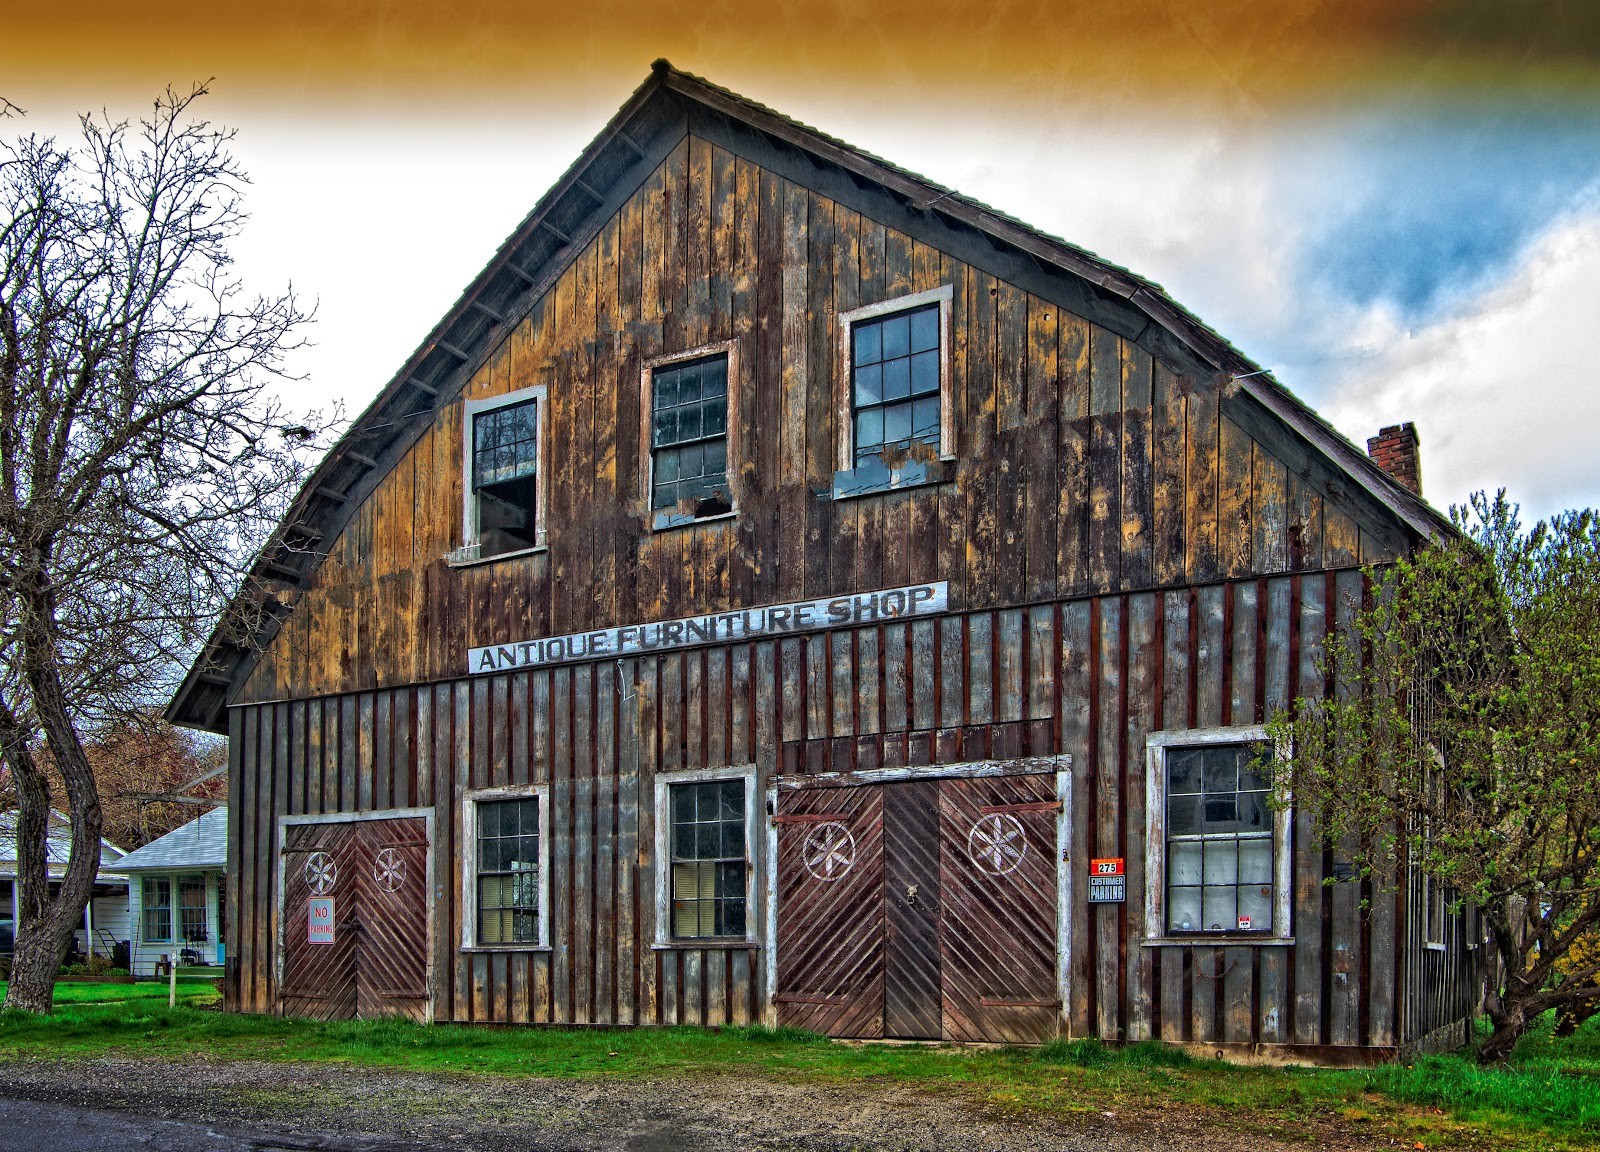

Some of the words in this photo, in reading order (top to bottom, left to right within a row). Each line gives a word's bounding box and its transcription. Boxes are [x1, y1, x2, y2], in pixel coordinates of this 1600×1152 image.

[479, 632, 608, 671] ANTIQUE
[618, 603, 816, 653] FURNITURE
[827, 586, 933, 624] SHOP
[1099, 864, 1115, 872] 275
[1091, 877, 1123, 885] CUSTOMER
[1091, 886, 1122, 899] PARKING
[315, 907, 328, 918] NO
[310, 925, 332, 933] PARKING
